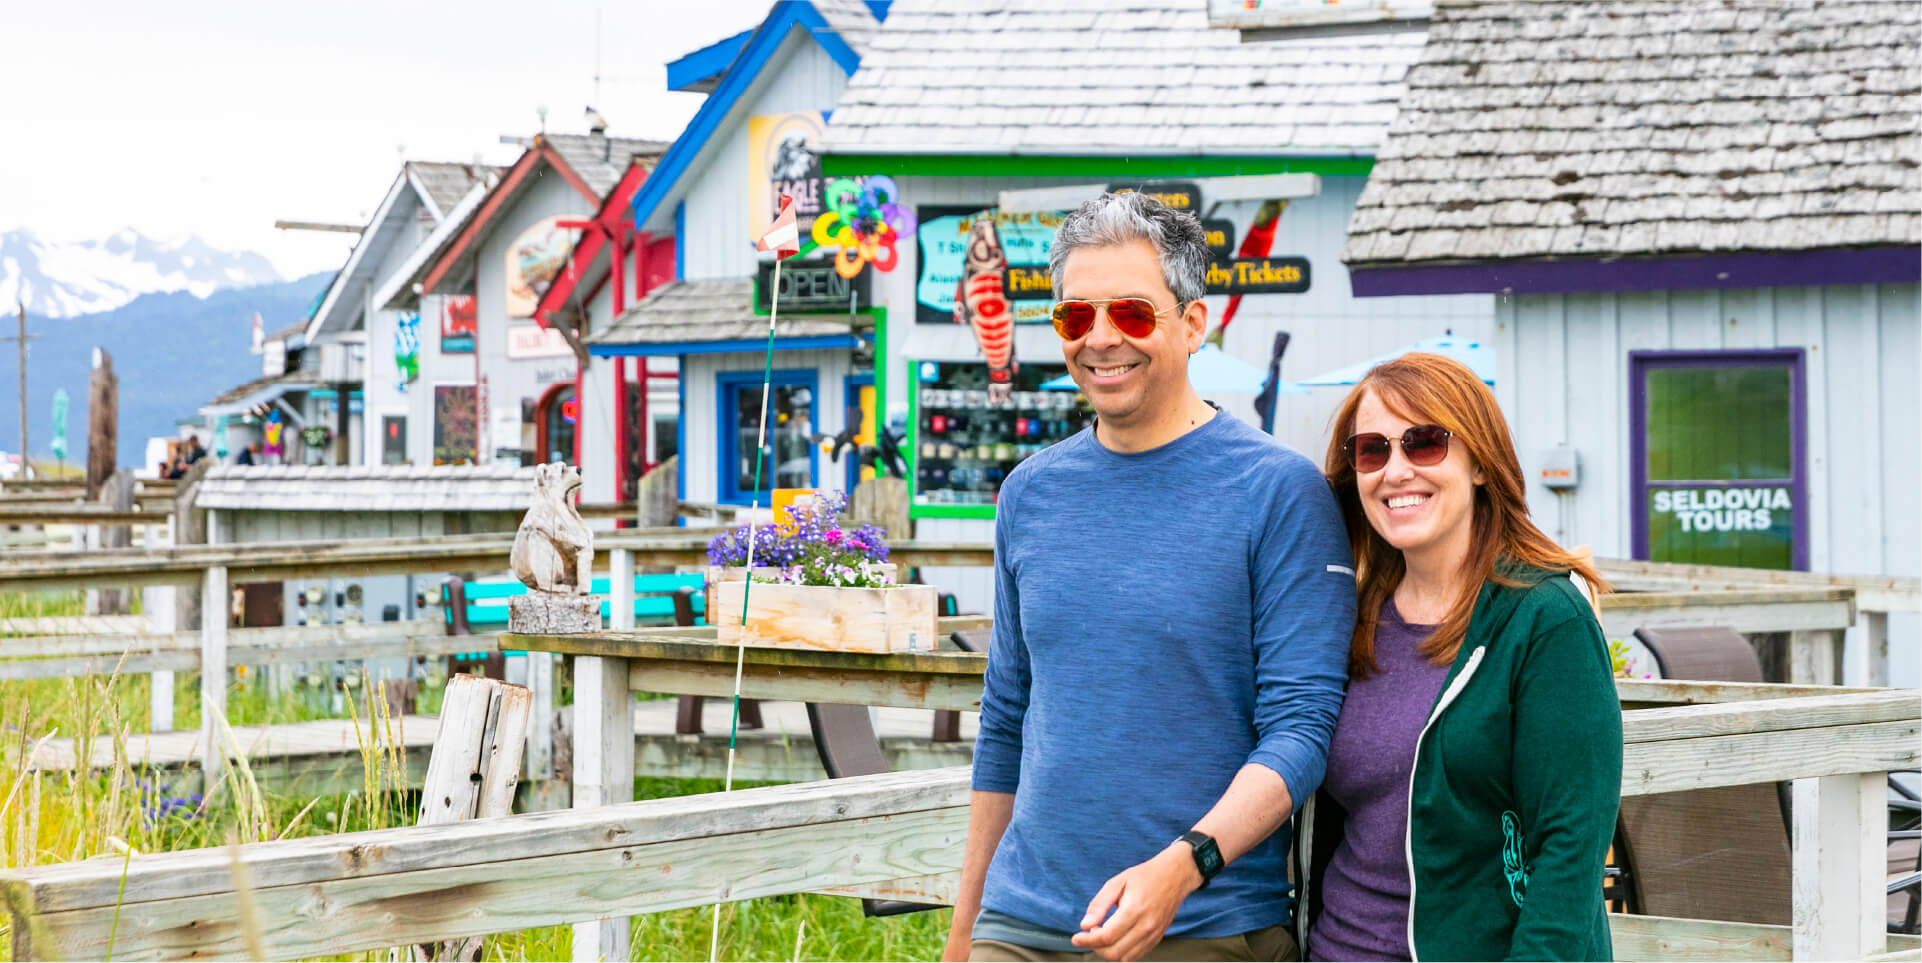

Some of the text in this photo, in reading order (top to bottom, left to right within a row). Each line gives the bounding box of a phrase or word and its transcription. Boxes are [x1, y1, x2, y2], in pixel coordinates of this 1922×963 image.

[776, 269, 848, 298] OPEN
[1008, 268, 1053, 291] Fishi
[1234, 261, 1300, 284] Tickets
[1654, 489, 1792, 512] SELDOVIA
[1676, 509, 1771, 532] TOURS
